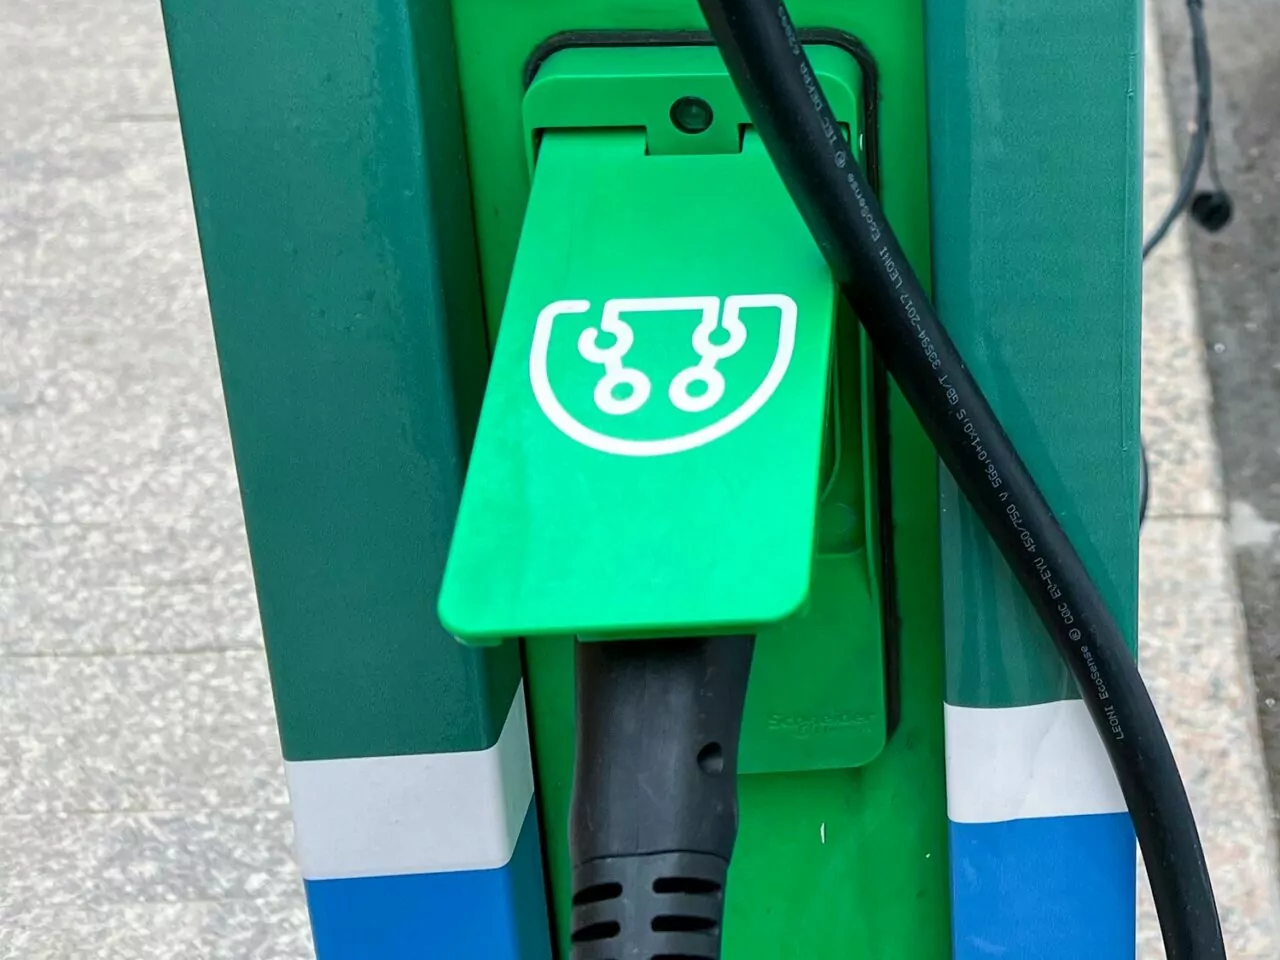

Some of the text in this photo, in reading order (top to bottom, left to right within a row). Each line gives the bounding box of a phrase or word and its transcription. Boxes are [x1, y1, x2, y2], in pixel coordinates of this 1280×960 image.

[796, 61, 824, 112] DEKRA
[818, 115, 839, 145] IEC
[842, 171, 883, 242] EcoSense
[876, 245, 905, 289] LEONI
[897, 292, 944, 369] 33594-2017
[937, 372, 961, 405] GB/T
[998, 490, 1010, 500] V
[1004, 502, 1038, 554] 450/750
[1056, 601, 1074, 625] CQC
[1077, 644, 1110, 700] EcoSense
[1102, 704, 1125, 741] LEONI
